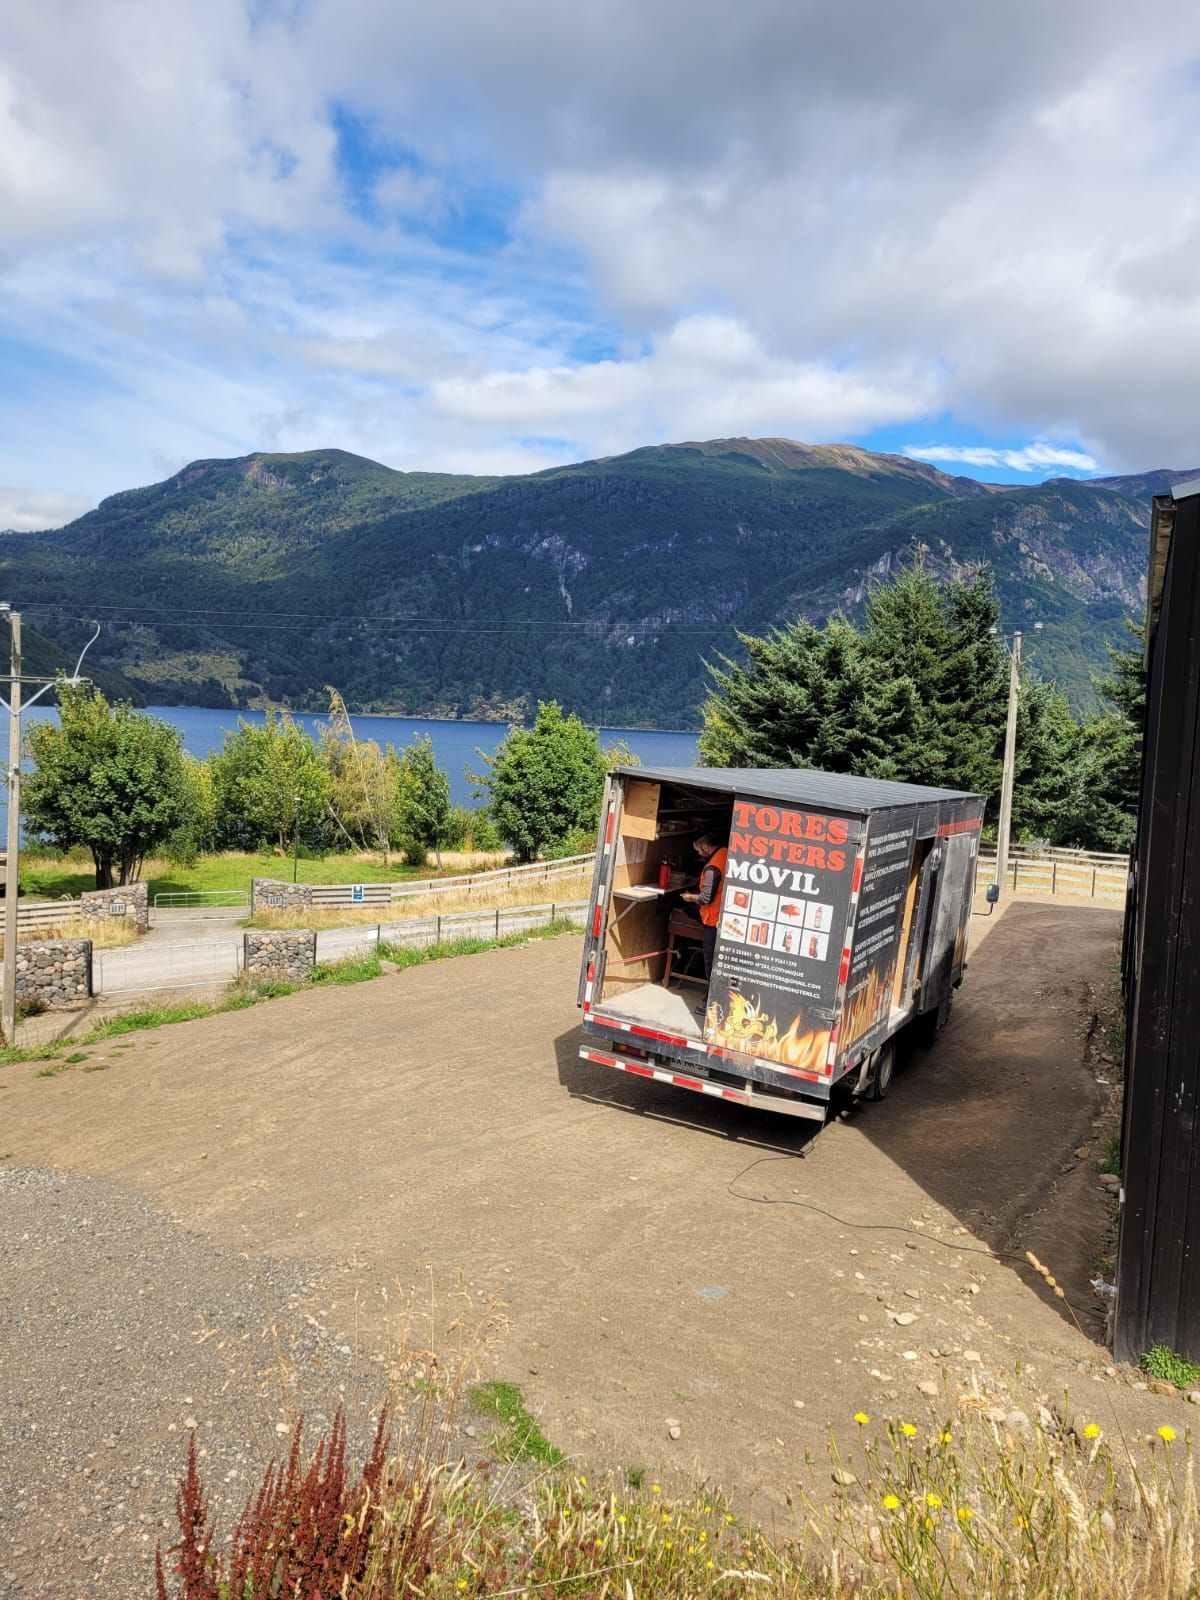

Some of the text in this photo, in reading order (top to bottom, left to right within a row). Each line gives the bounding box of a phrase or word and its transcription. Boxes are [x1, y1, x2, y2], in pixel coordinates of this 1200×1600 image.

[735, 802, 849, 845] TORES
[729, 831, 846, 872] NSTERS
[726, 858, 820, 895] MÓVIL
[739, 958, 754, 966] MAYO
